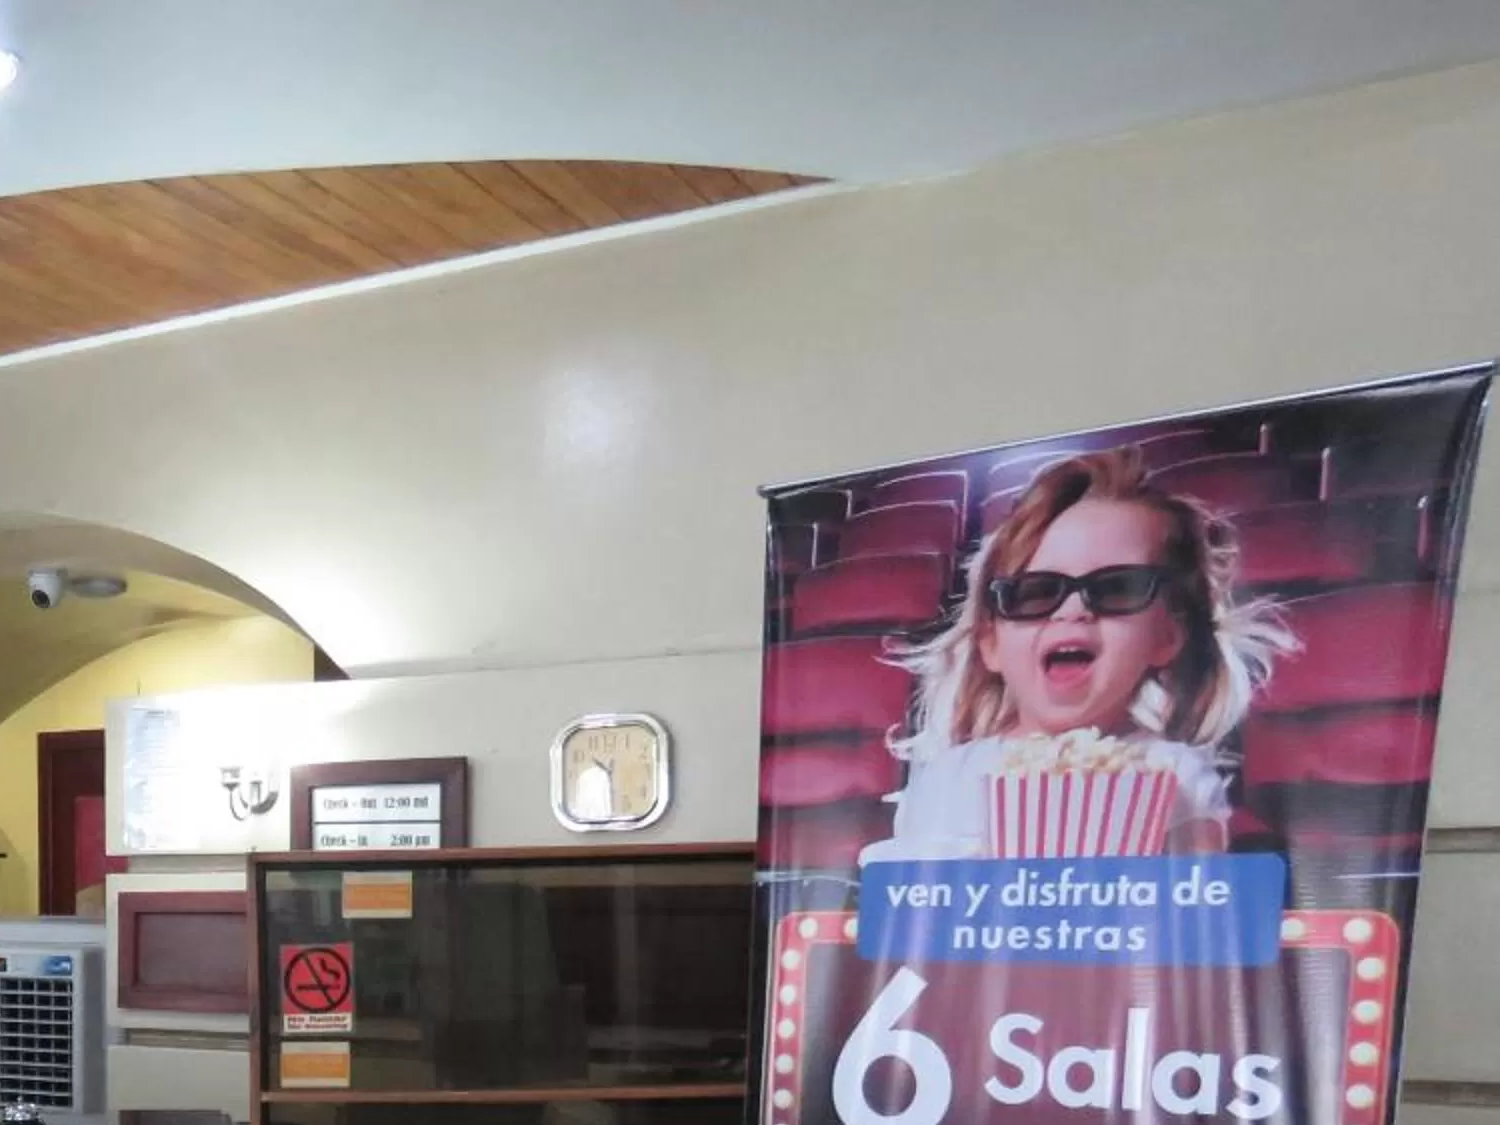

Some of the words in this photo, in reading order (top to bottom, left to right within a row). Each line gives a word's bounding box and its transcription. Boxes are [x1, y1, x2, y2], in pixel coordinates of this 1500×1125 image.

[887, 881, 952, 908] ven
[965, 882, 990, 916] y
[1001, 868, 1158, 907] disfruta
[1173, 866, 1231, 905] de
[953, 922, 1147, 951] nuestras
[984, 1007, 1282, 1120] Salas
